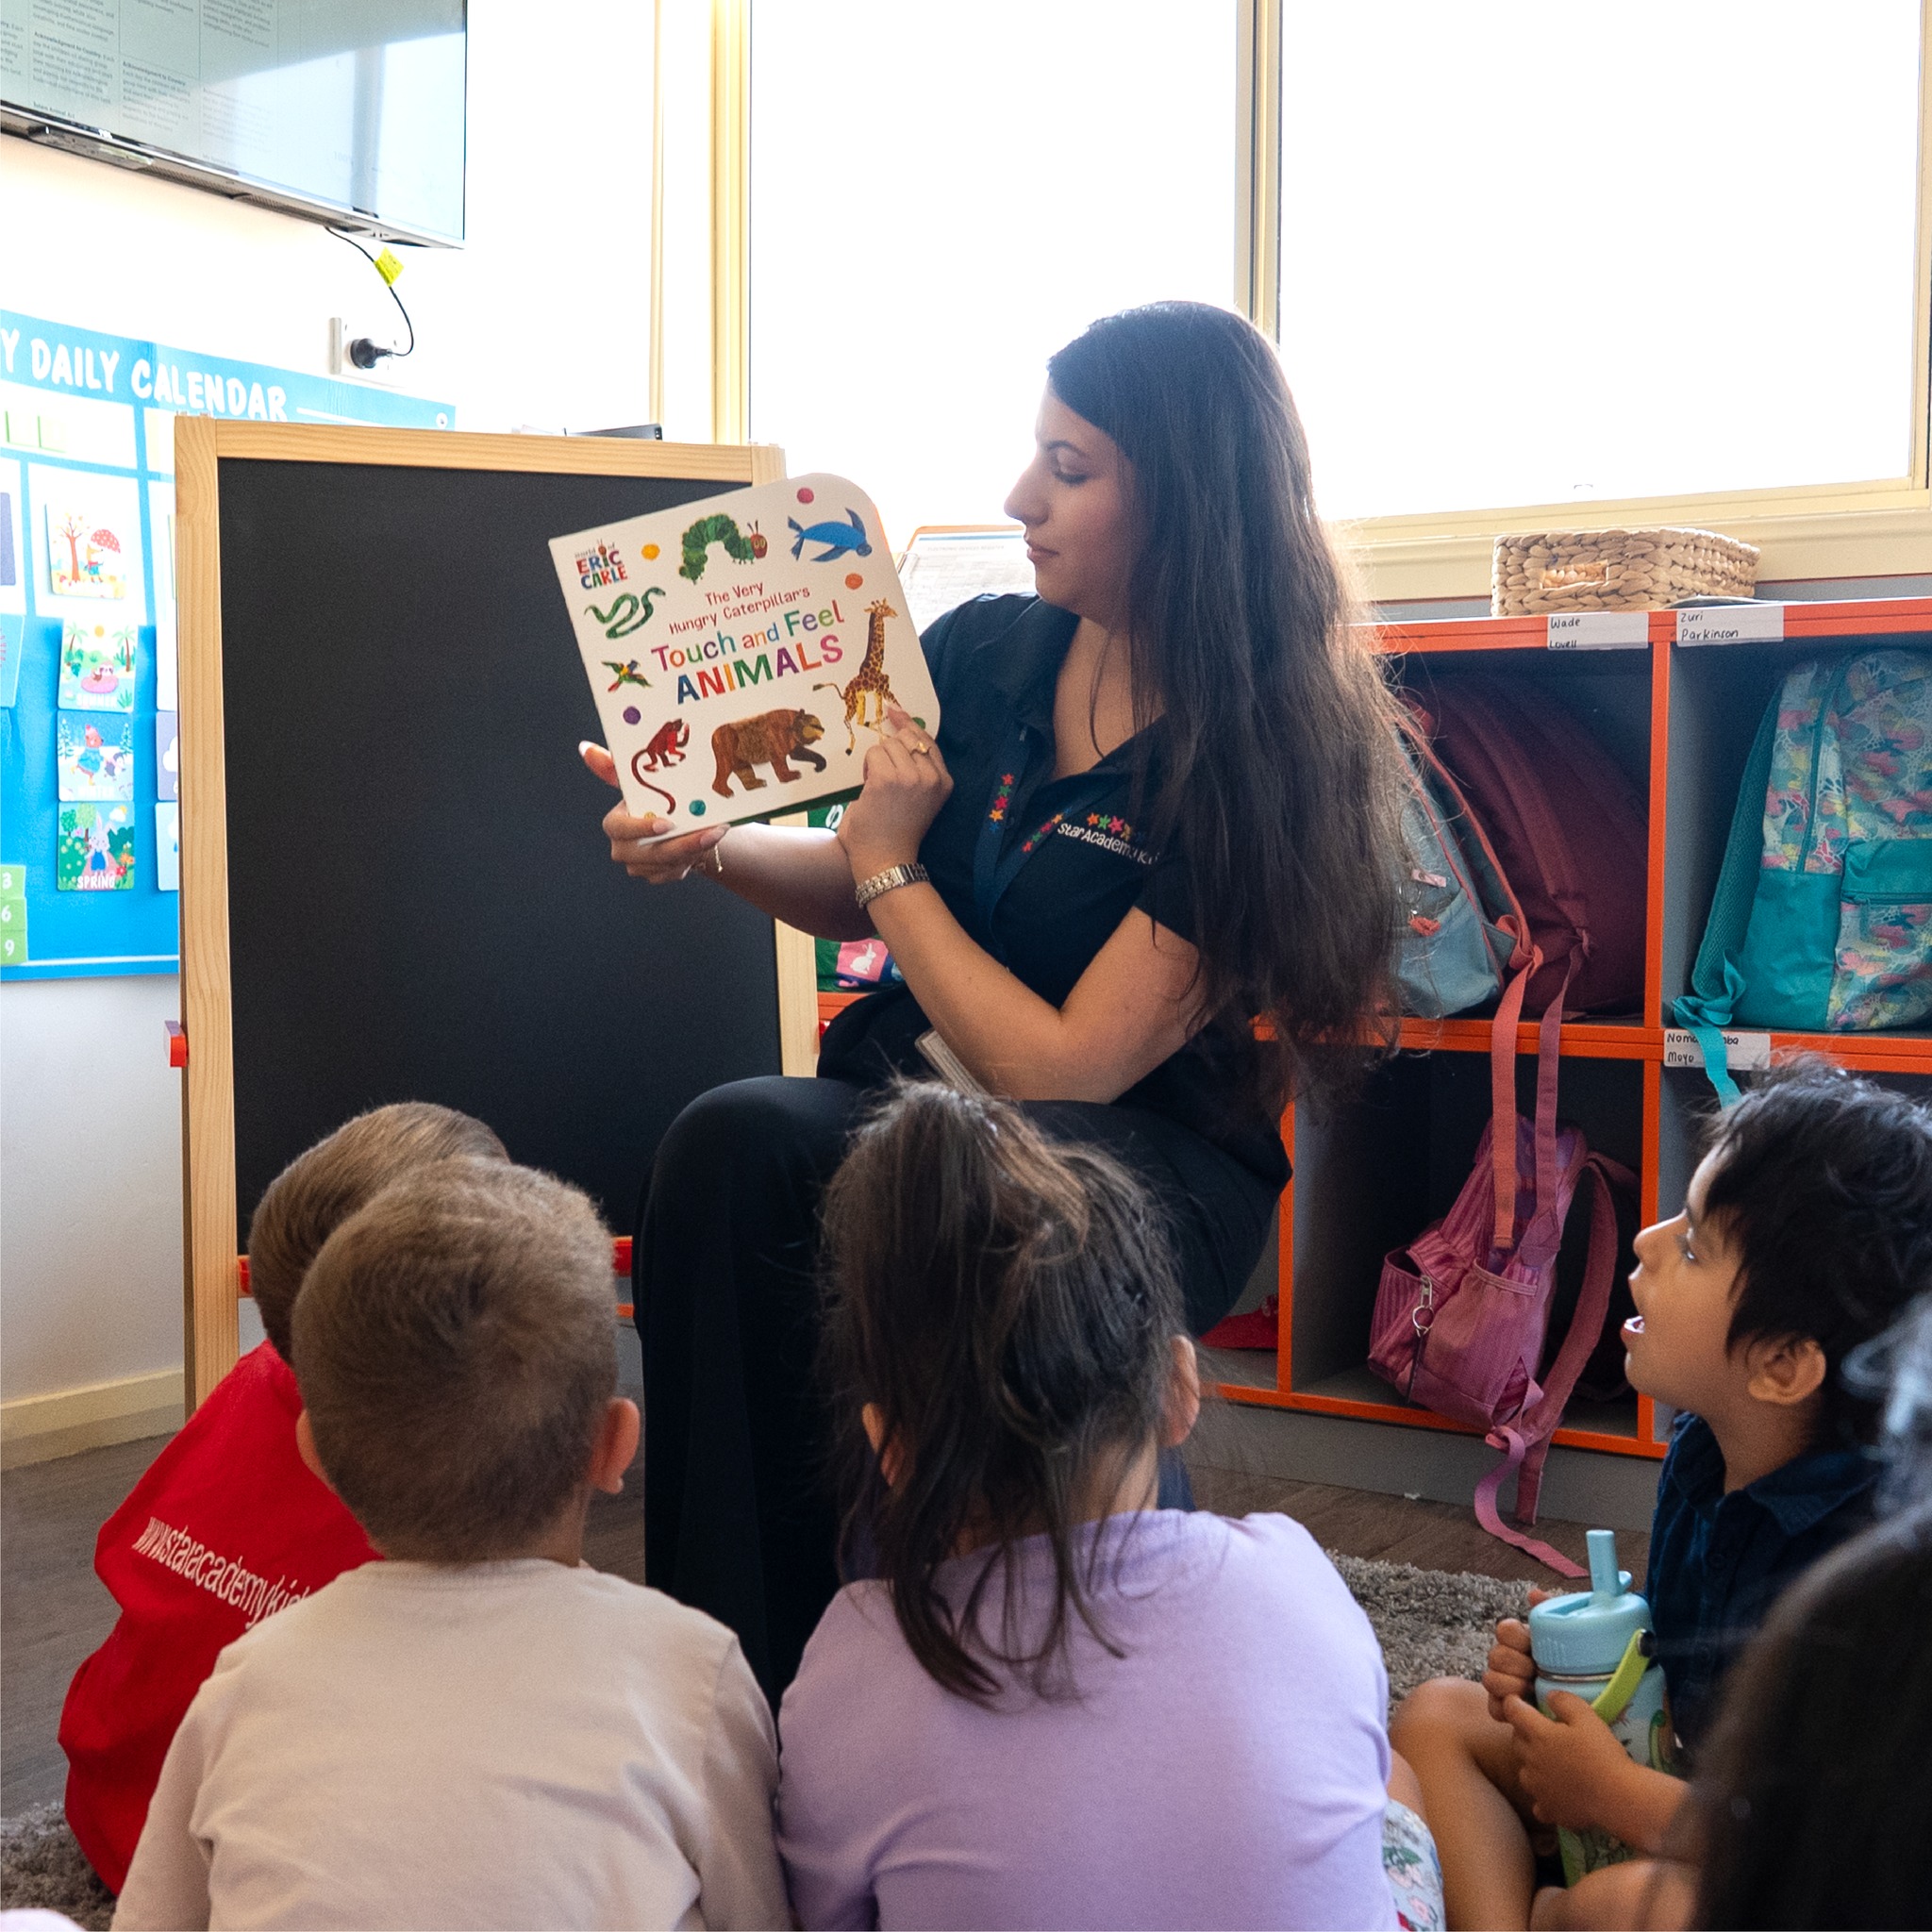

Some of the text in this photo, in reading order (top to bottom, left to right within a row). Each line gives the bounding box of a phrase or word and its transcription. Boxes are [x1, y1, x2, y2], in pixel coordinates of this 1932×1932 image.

[30, 338, 120, 393] DAILY
[131, 358, 288, 423] CALENDAR
[576, 550, 623, 575] ERIC
[580, 563, 628, 590] CARLE
[705, 582, 764, 607] The Very
[669, 587, 810, 635] Hungry Caterpillar's
[1680, 611, 1704, 623] Zuri
[1550, 617, 1581, 629] Wade
[651, 600, 845, 672] Touch and Feel
[1681, 629, 1739, 641] Parkinson
[1549, 640, 1577, 649] Lovell
[677, 634, 843, 705] ANIMALS
[2, 872, 12, 890] 3
[76, 874, 116, 890] SPRING
[1, 905, 12, 923] 6
[4, 939, 15, 957] 9
[1668, 1051, 1694, 1066] Moyo
